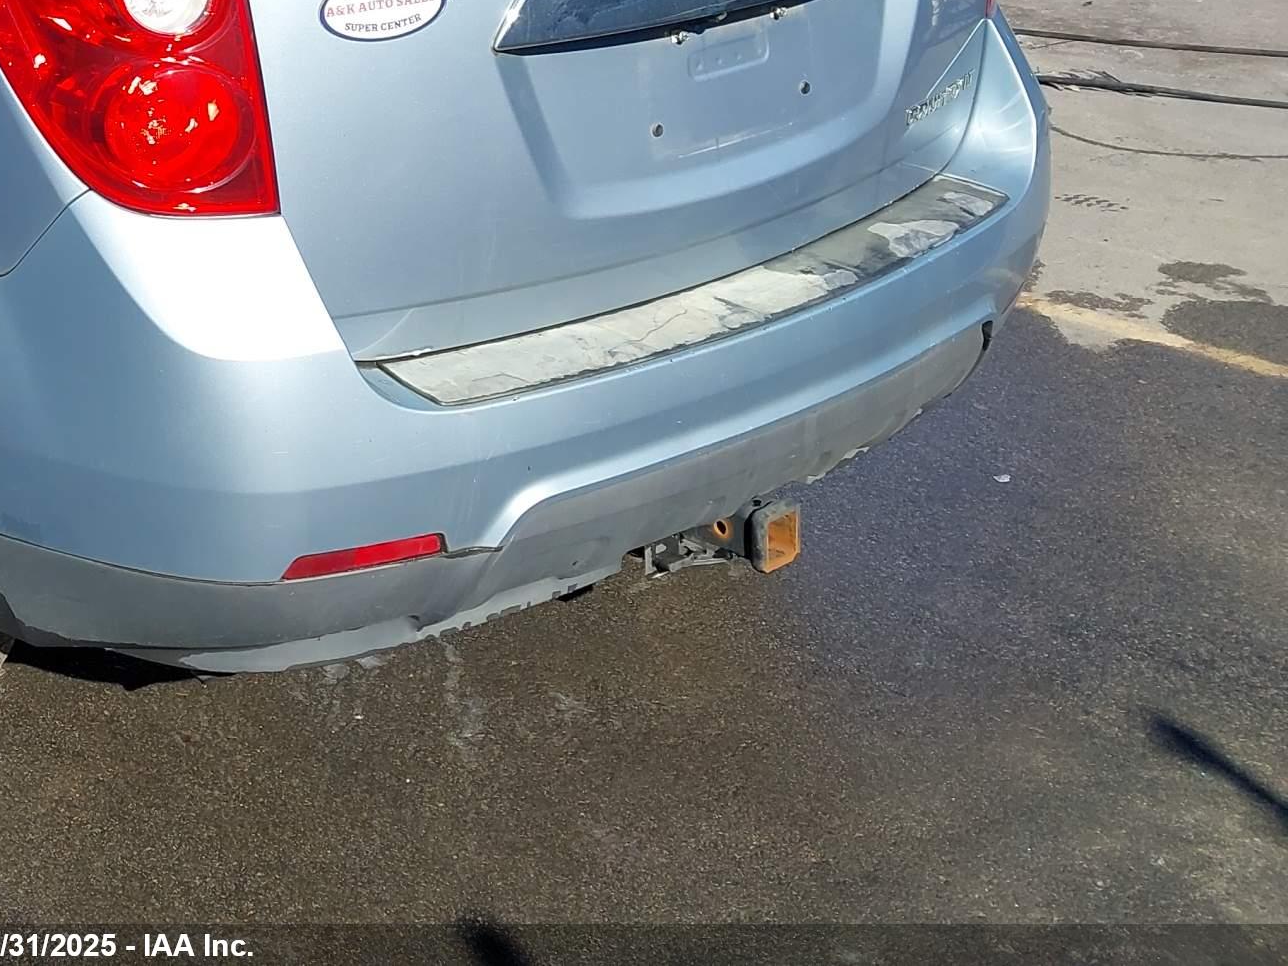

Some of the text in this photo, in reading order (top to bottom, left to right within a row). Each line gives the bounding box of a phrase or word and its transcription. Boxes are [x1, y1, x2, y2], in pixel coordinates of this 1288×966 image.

[326, 4, 355, 18] A&K
[345, 13, 422, 32] SUPER CENTER
